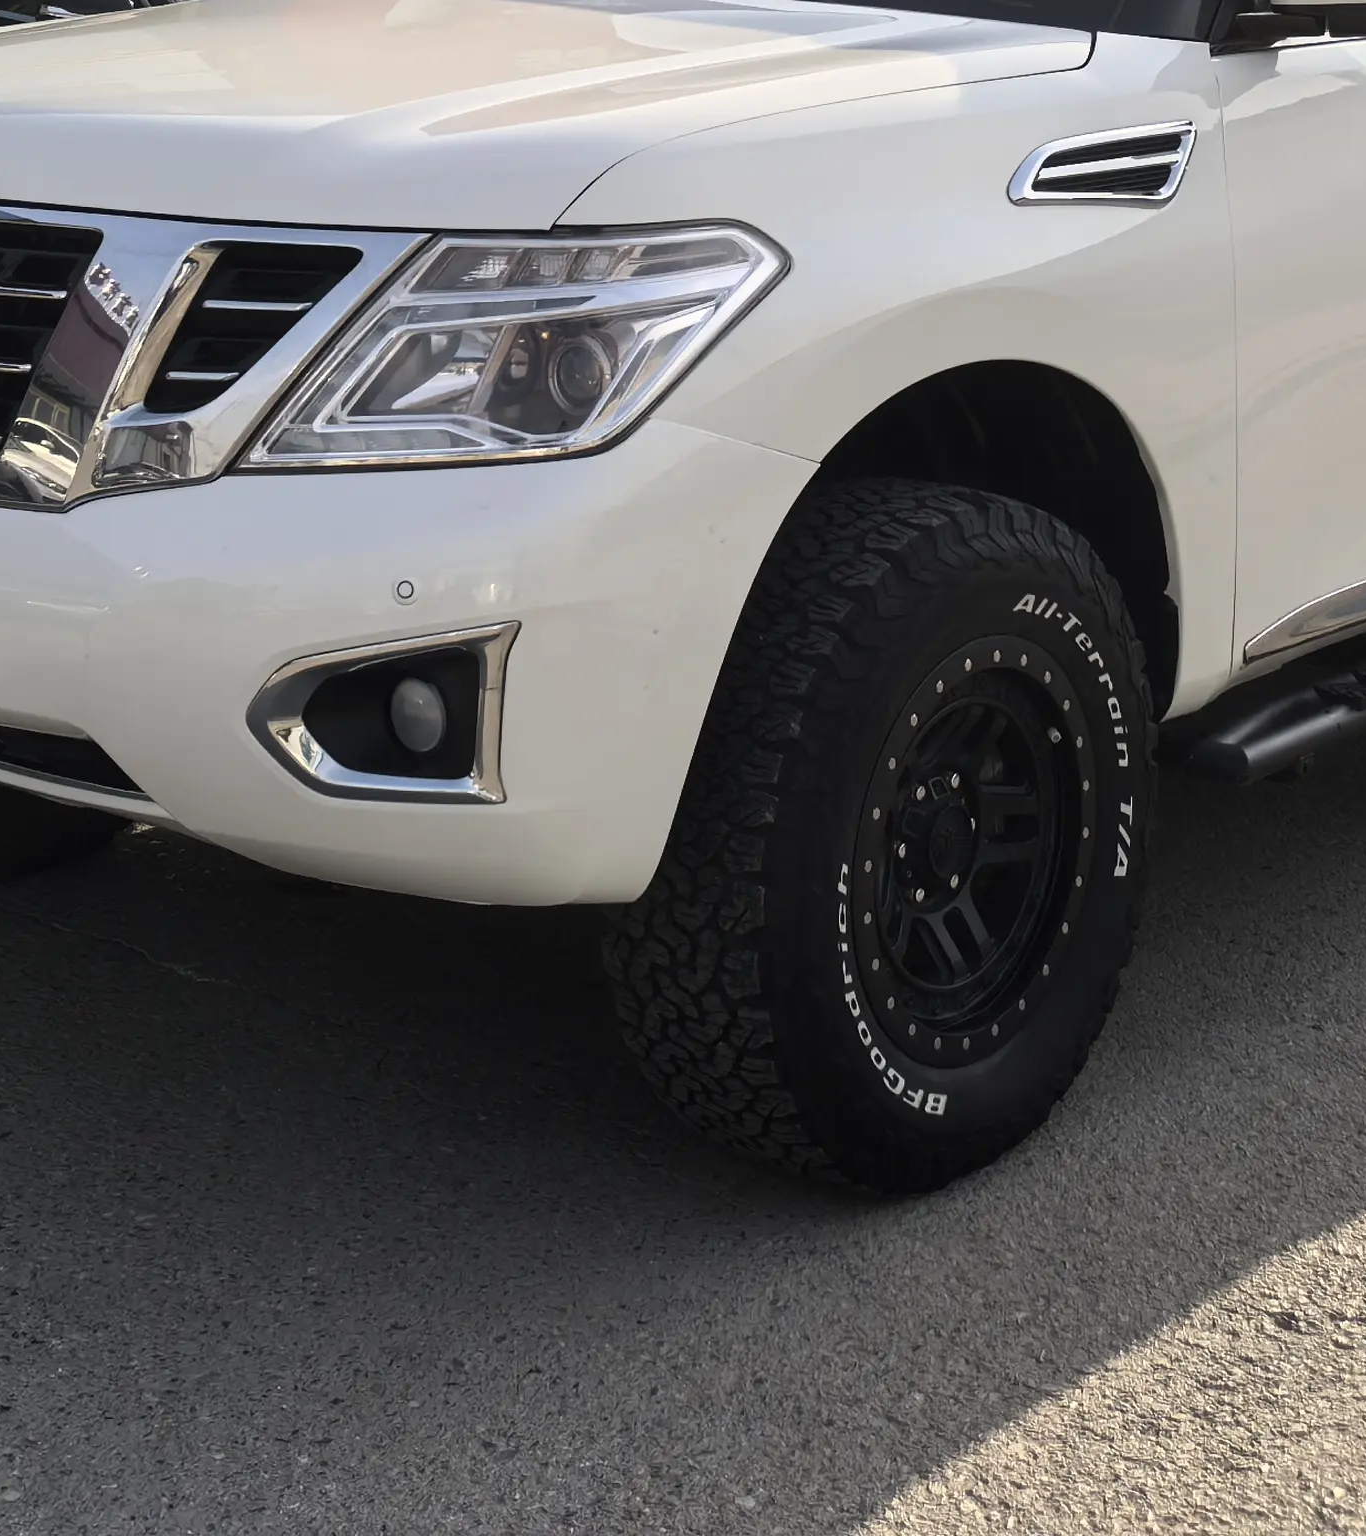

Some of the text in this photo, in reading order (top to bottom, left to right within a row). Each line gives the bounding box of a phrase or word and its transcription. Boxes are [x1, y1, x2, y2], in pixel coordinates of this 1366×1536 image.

[1011, 593, 1135, 878] All-Terrain T/A
[837, 864, 948, 1115] BFGoodrich
